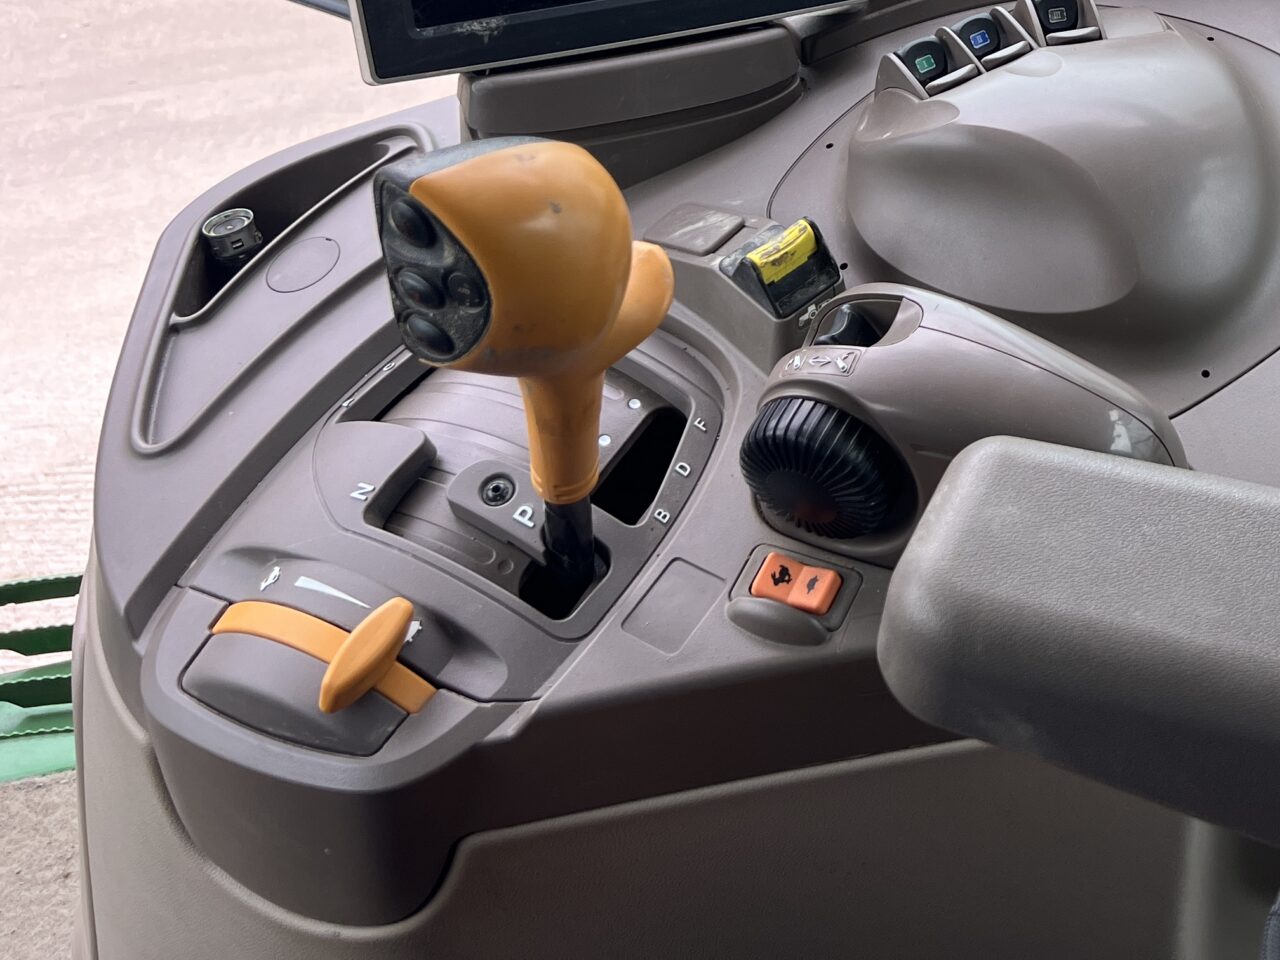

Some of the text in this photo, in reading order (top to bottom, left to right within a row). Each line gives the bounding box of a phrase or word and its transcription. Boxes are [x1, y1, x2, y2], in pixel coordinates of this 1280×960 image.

[694, 417, 708, 432] F
[675, 462, 692, 477] D
[350, 482, 376, 502] N
[512, 505, 536, 529] P
[654, 508, 671, 524] B
